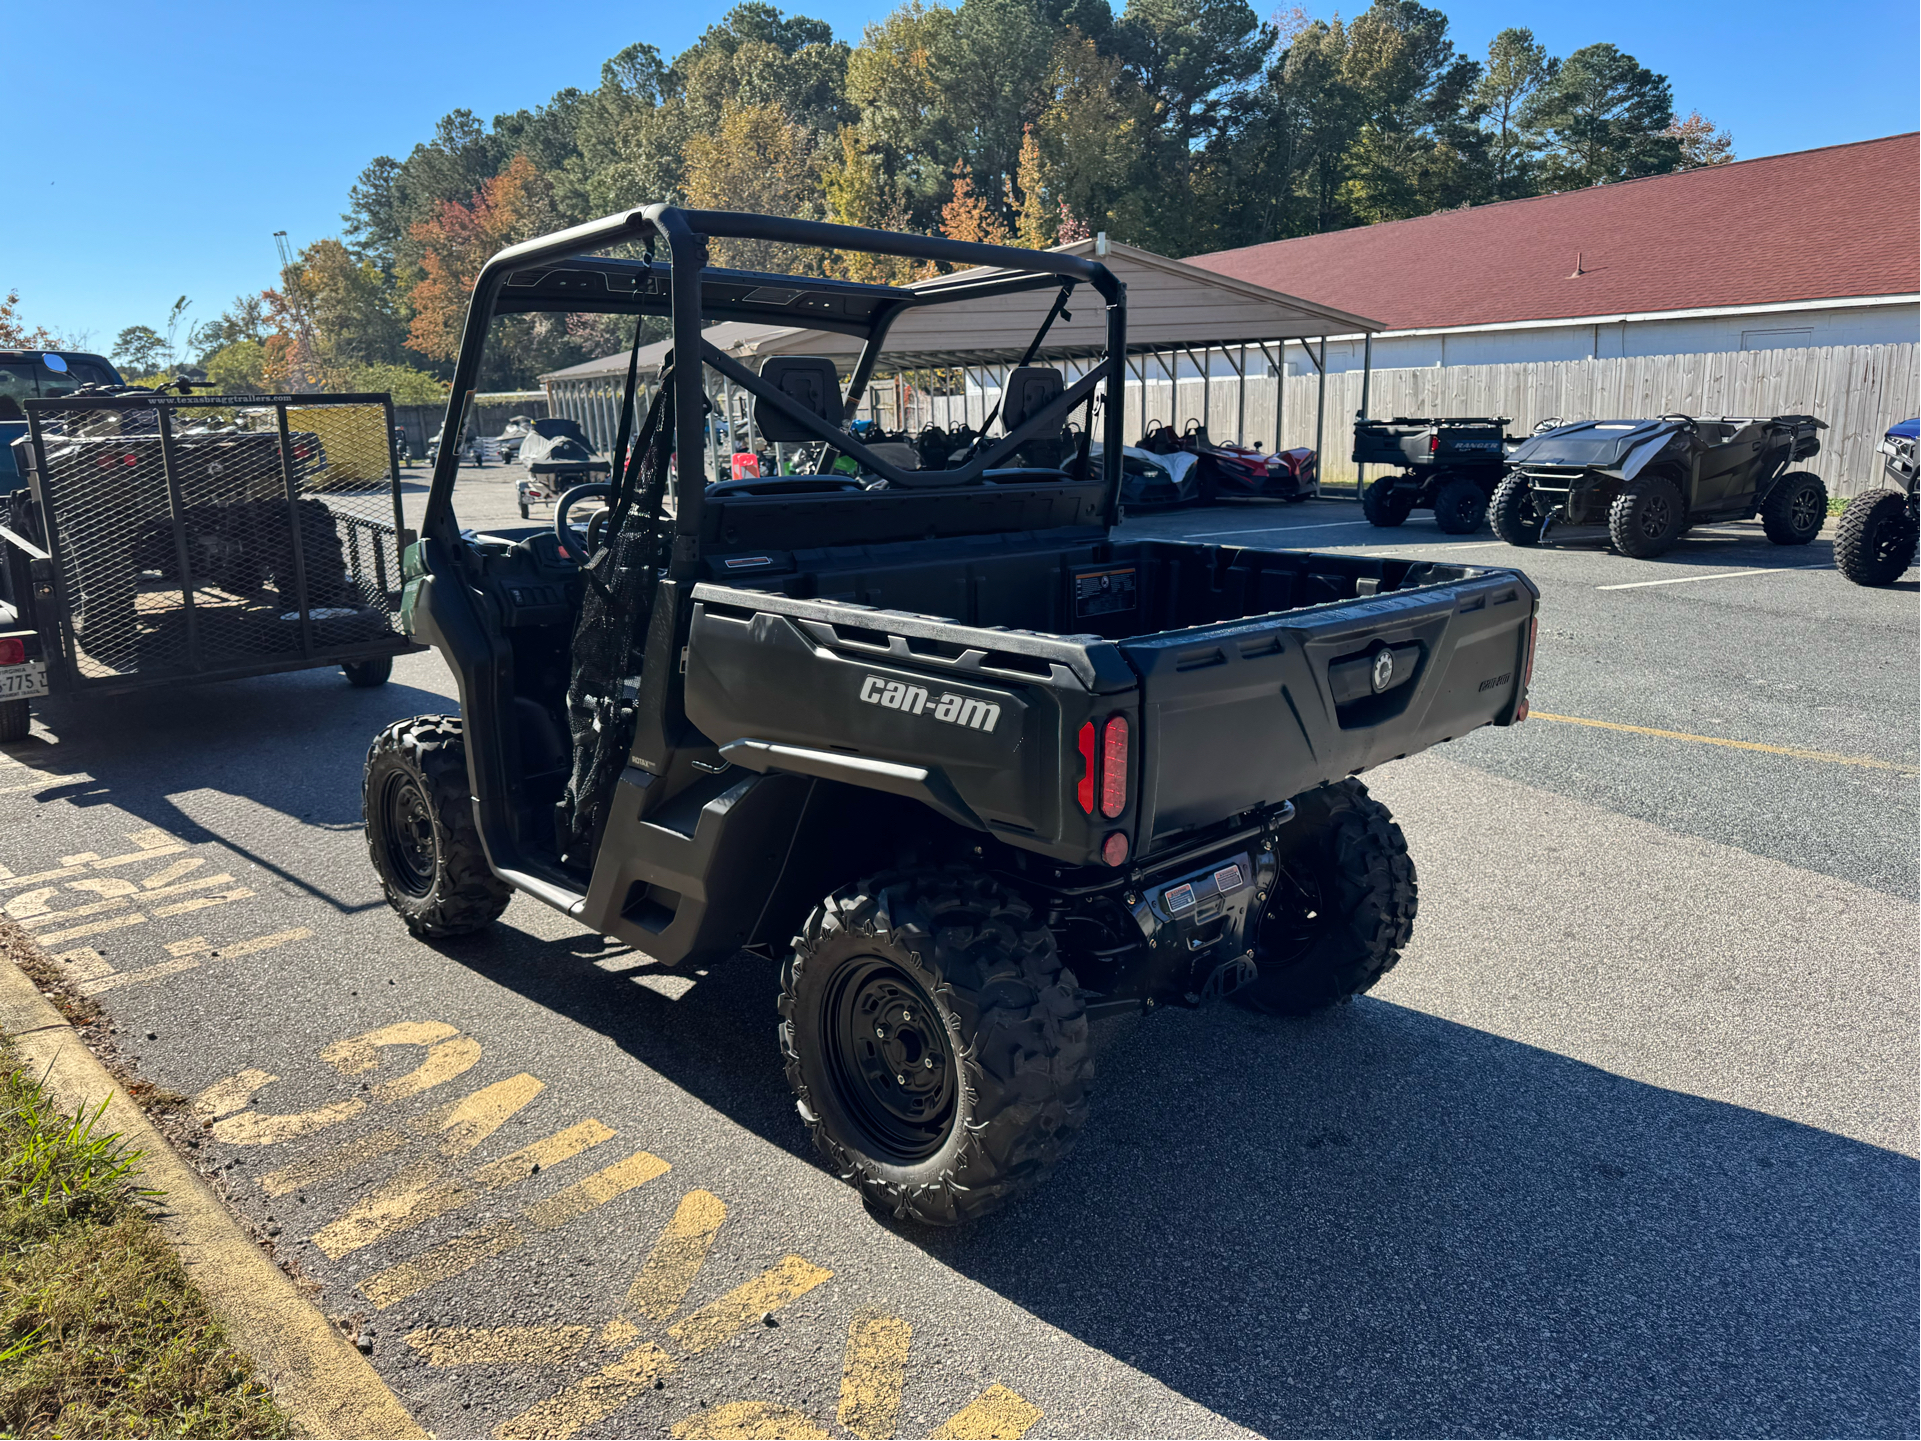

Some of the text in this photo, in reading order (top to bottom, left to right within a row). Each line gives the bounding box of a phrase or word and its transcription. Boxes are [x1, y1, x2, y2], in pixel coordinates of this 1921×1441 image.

[148, 394, 292, 404] www.texasbraggtrailers.com
[859, 676, 1001, 733] can-am
[631, 755, 650, 768] ROTAX
[0, 828, 315, 996] FIRE
